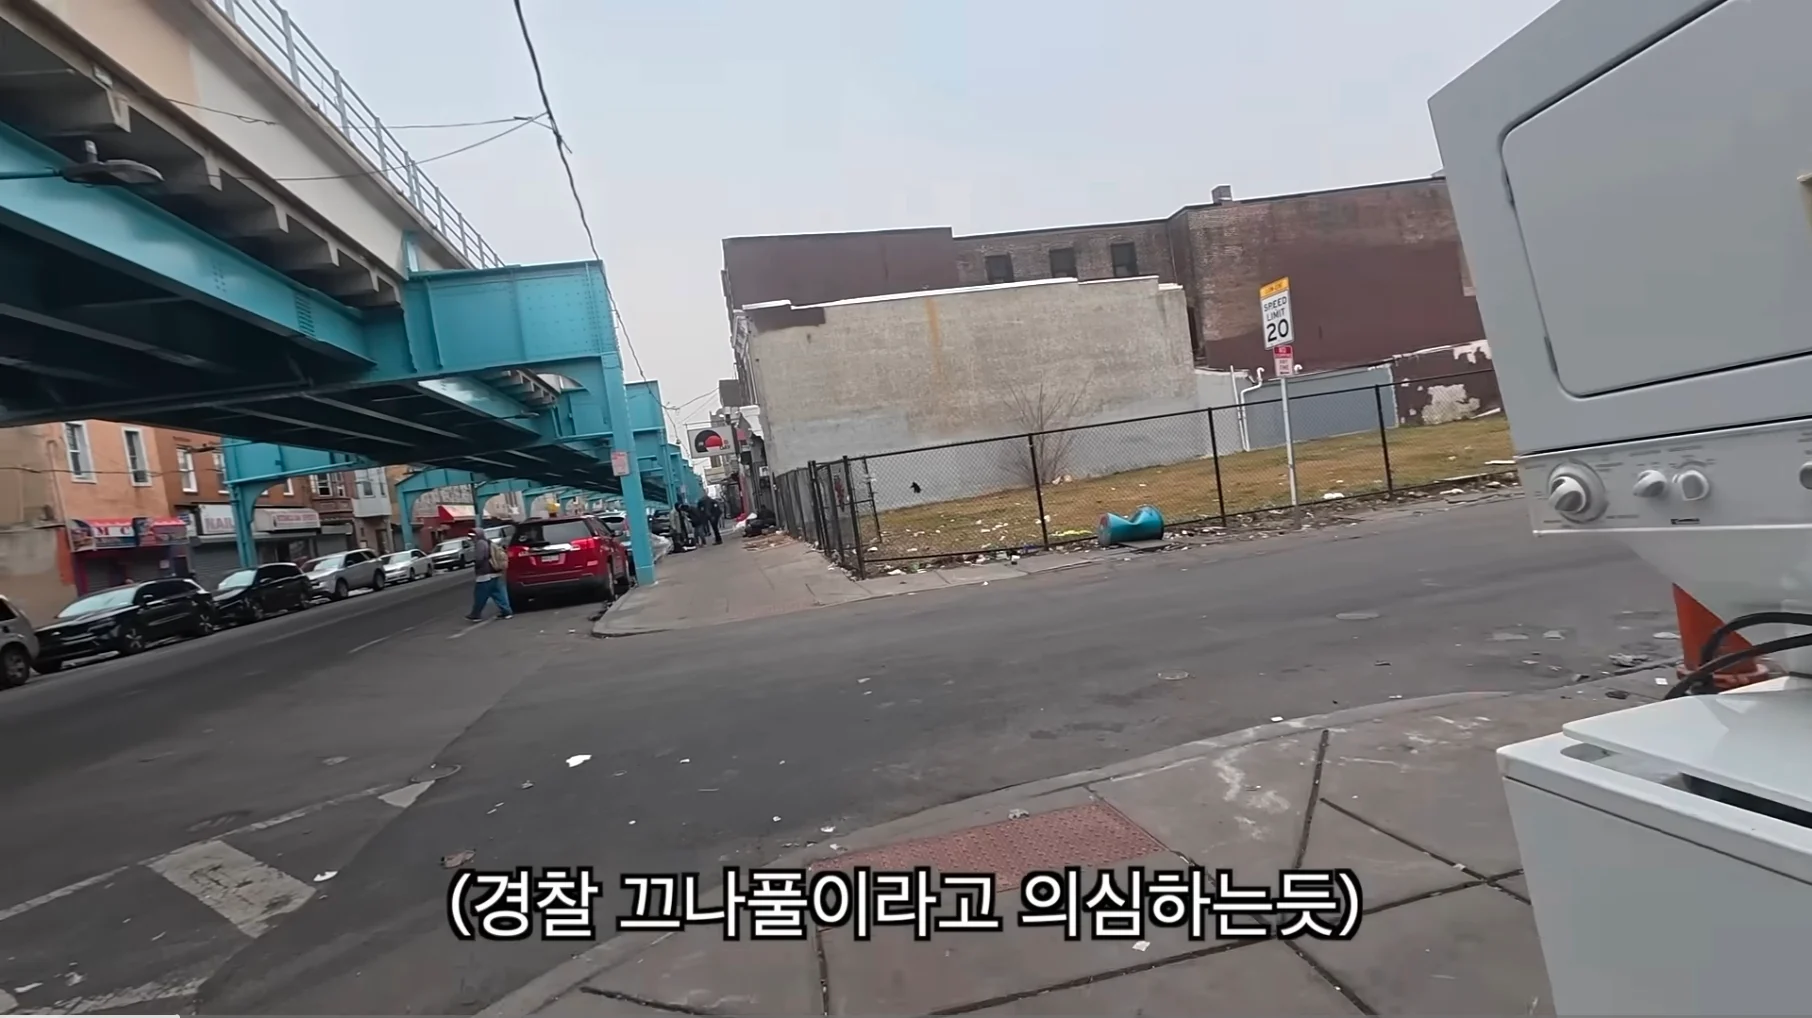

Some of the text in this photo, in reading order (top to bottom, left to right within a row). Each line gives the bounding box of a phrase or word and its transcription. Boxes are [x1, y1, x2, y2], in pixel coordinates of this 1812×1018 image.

[1263, 296, 1287, 312] SPEED
[1266, 307, 1286, 322] LIMIT
[1266, 318, 1289, 342] 20
